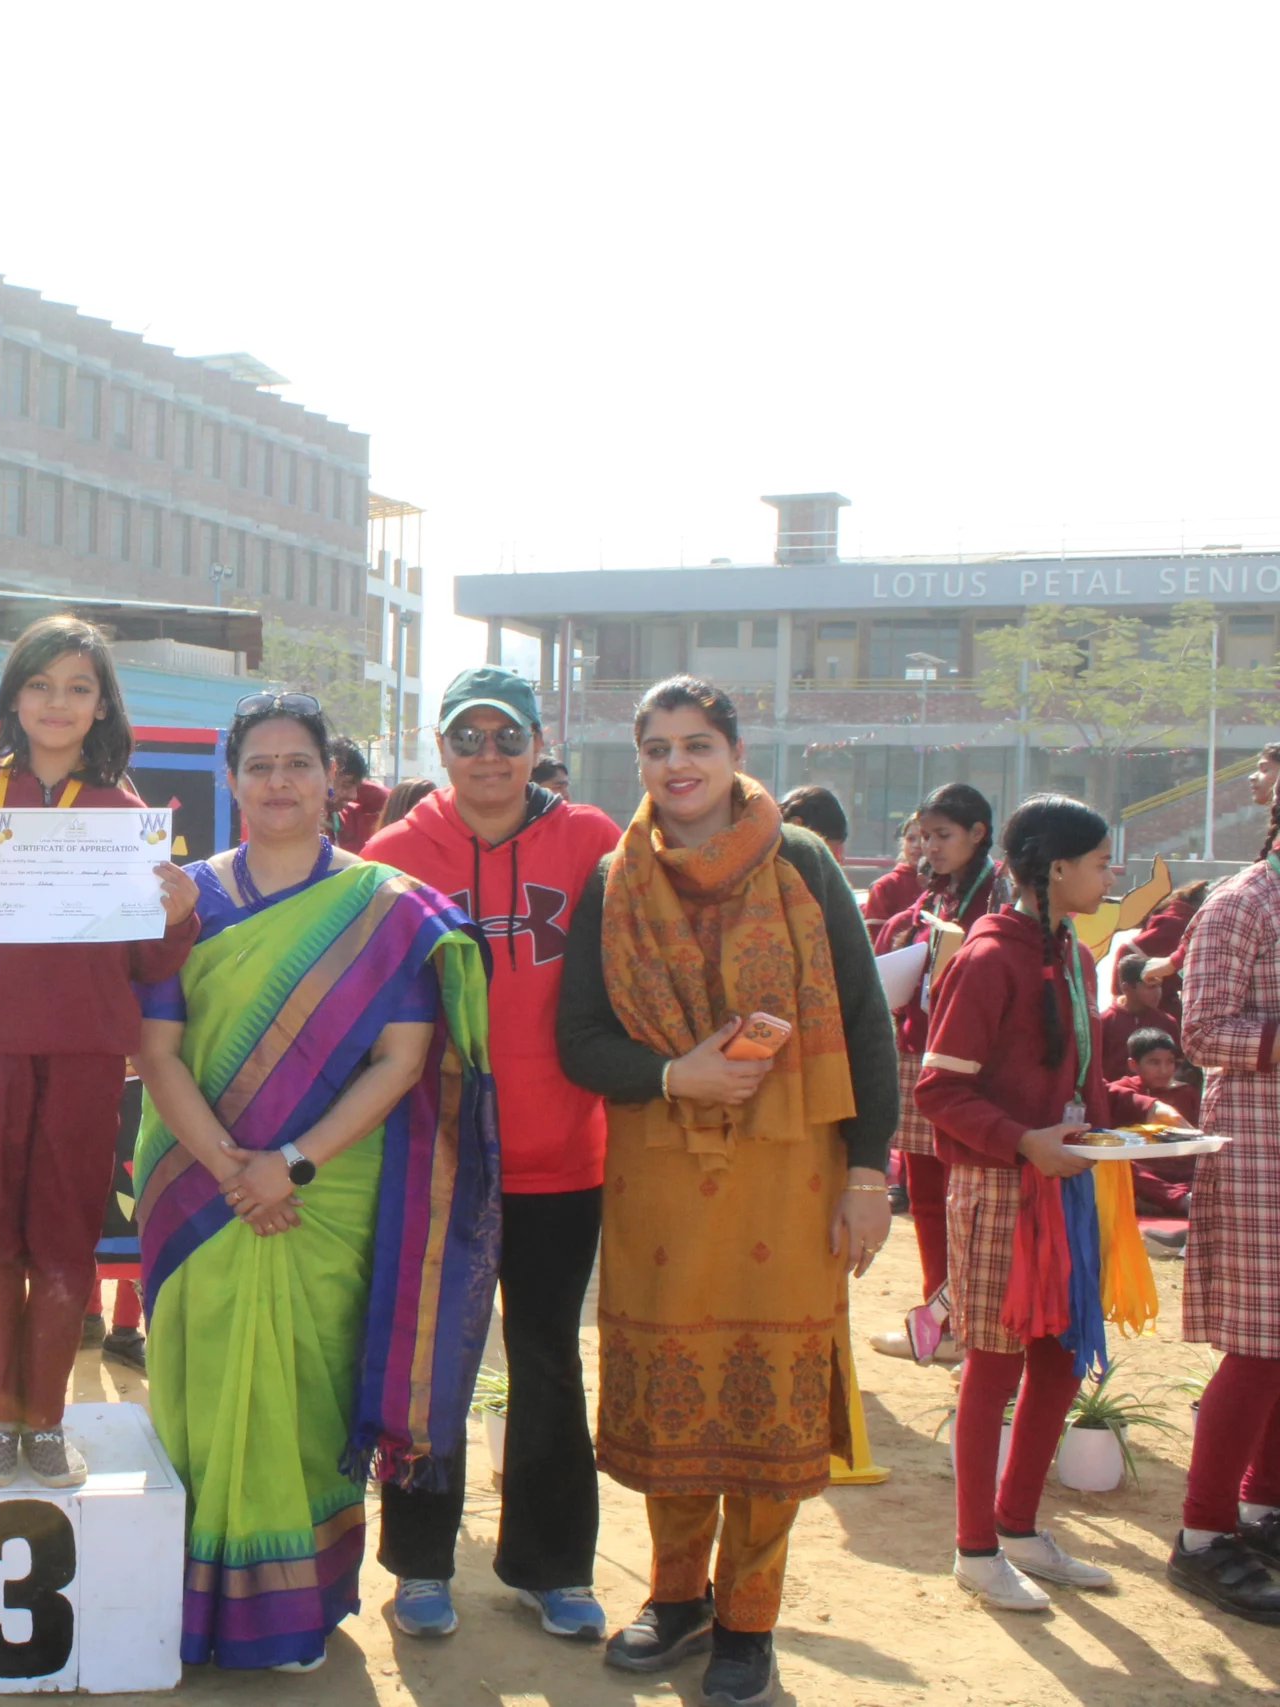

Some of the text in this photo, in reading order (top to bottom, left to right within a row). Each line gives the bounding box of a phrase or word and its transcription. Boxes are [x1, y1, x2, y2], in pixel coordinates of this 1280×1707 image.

[873, 565, 1280, 599] LOTUS PETAL SENIO
[12, 844, 139, 852] CERTIFICATE OF APPRECIATION
